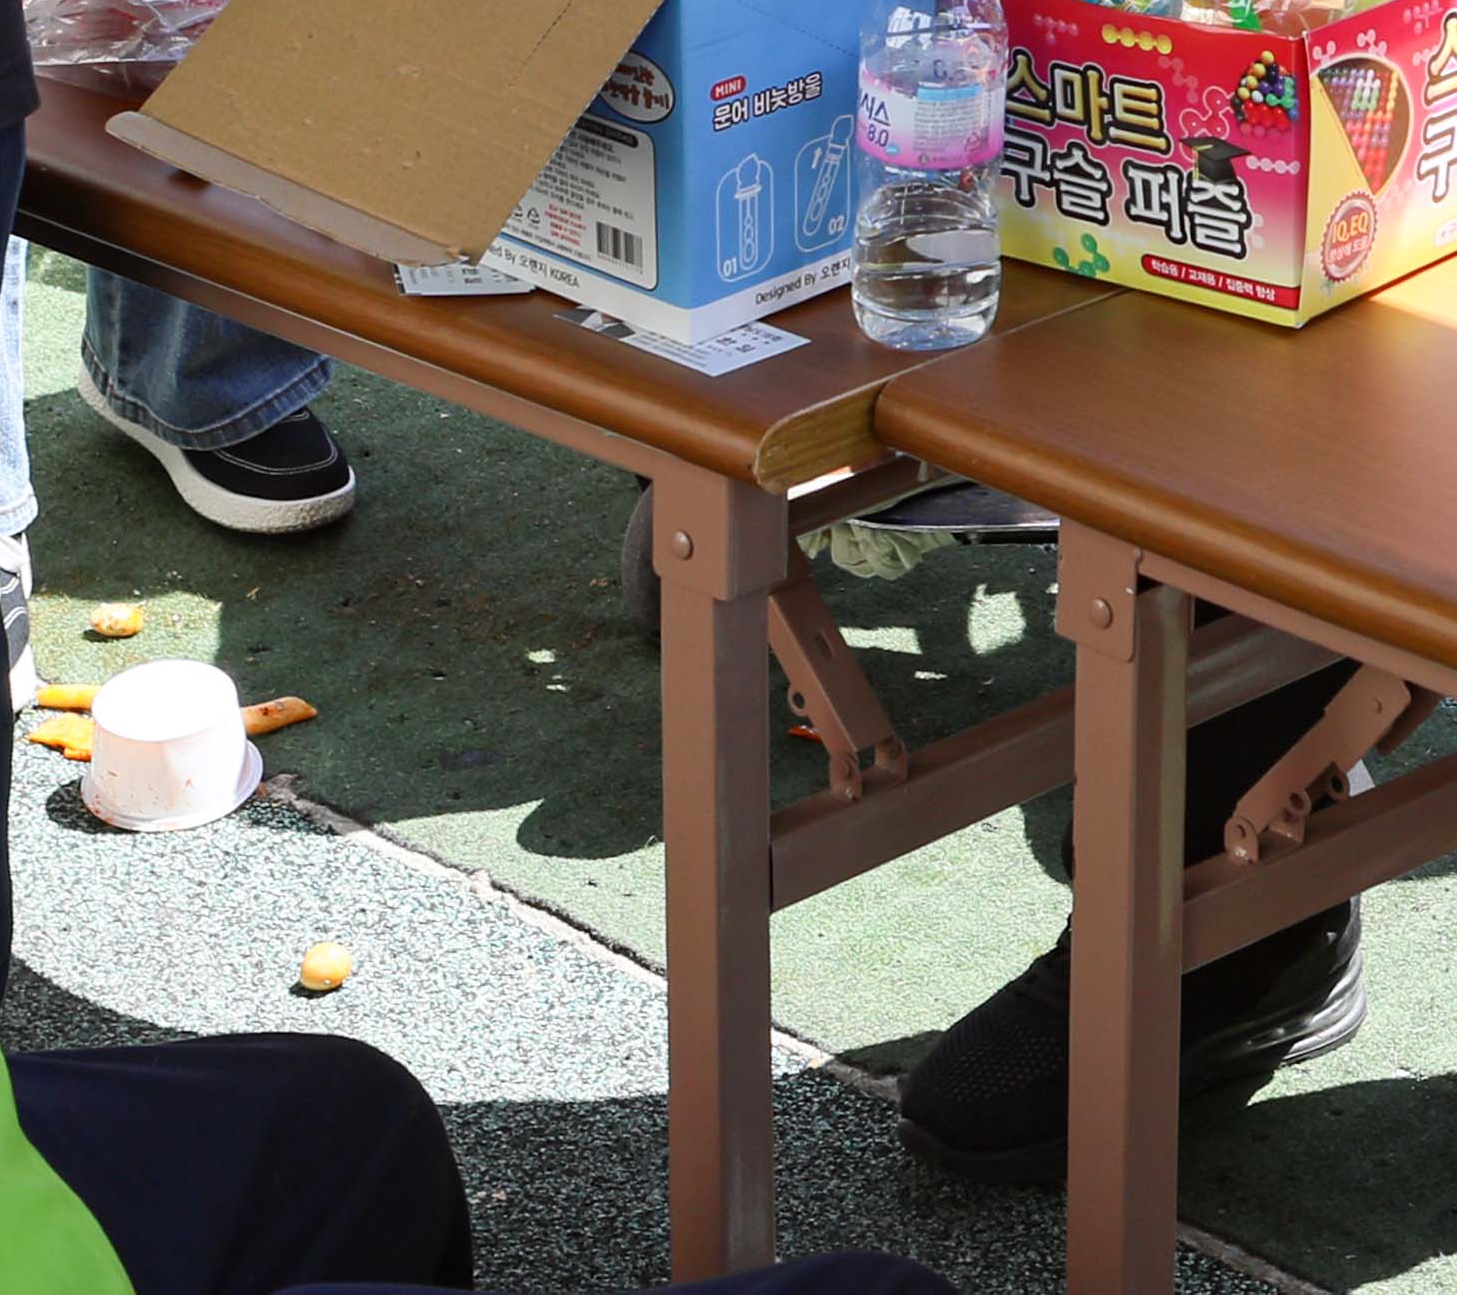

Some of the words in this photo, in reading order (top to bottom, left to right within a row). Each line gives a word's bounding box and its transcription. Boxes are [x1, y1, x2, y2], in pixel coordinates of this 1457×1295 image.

[715, 79, 742, 98] MINI
[1005, 50, 1172, 154] 스마트
[713, 99, 749, 132] 문어
[1002, 129, 1112, 226] 구슬
[1124, 159, 1252, 258] 퍼즐
[755, 274, 803, 306] Designed
[804, 272, 817, 290] By
